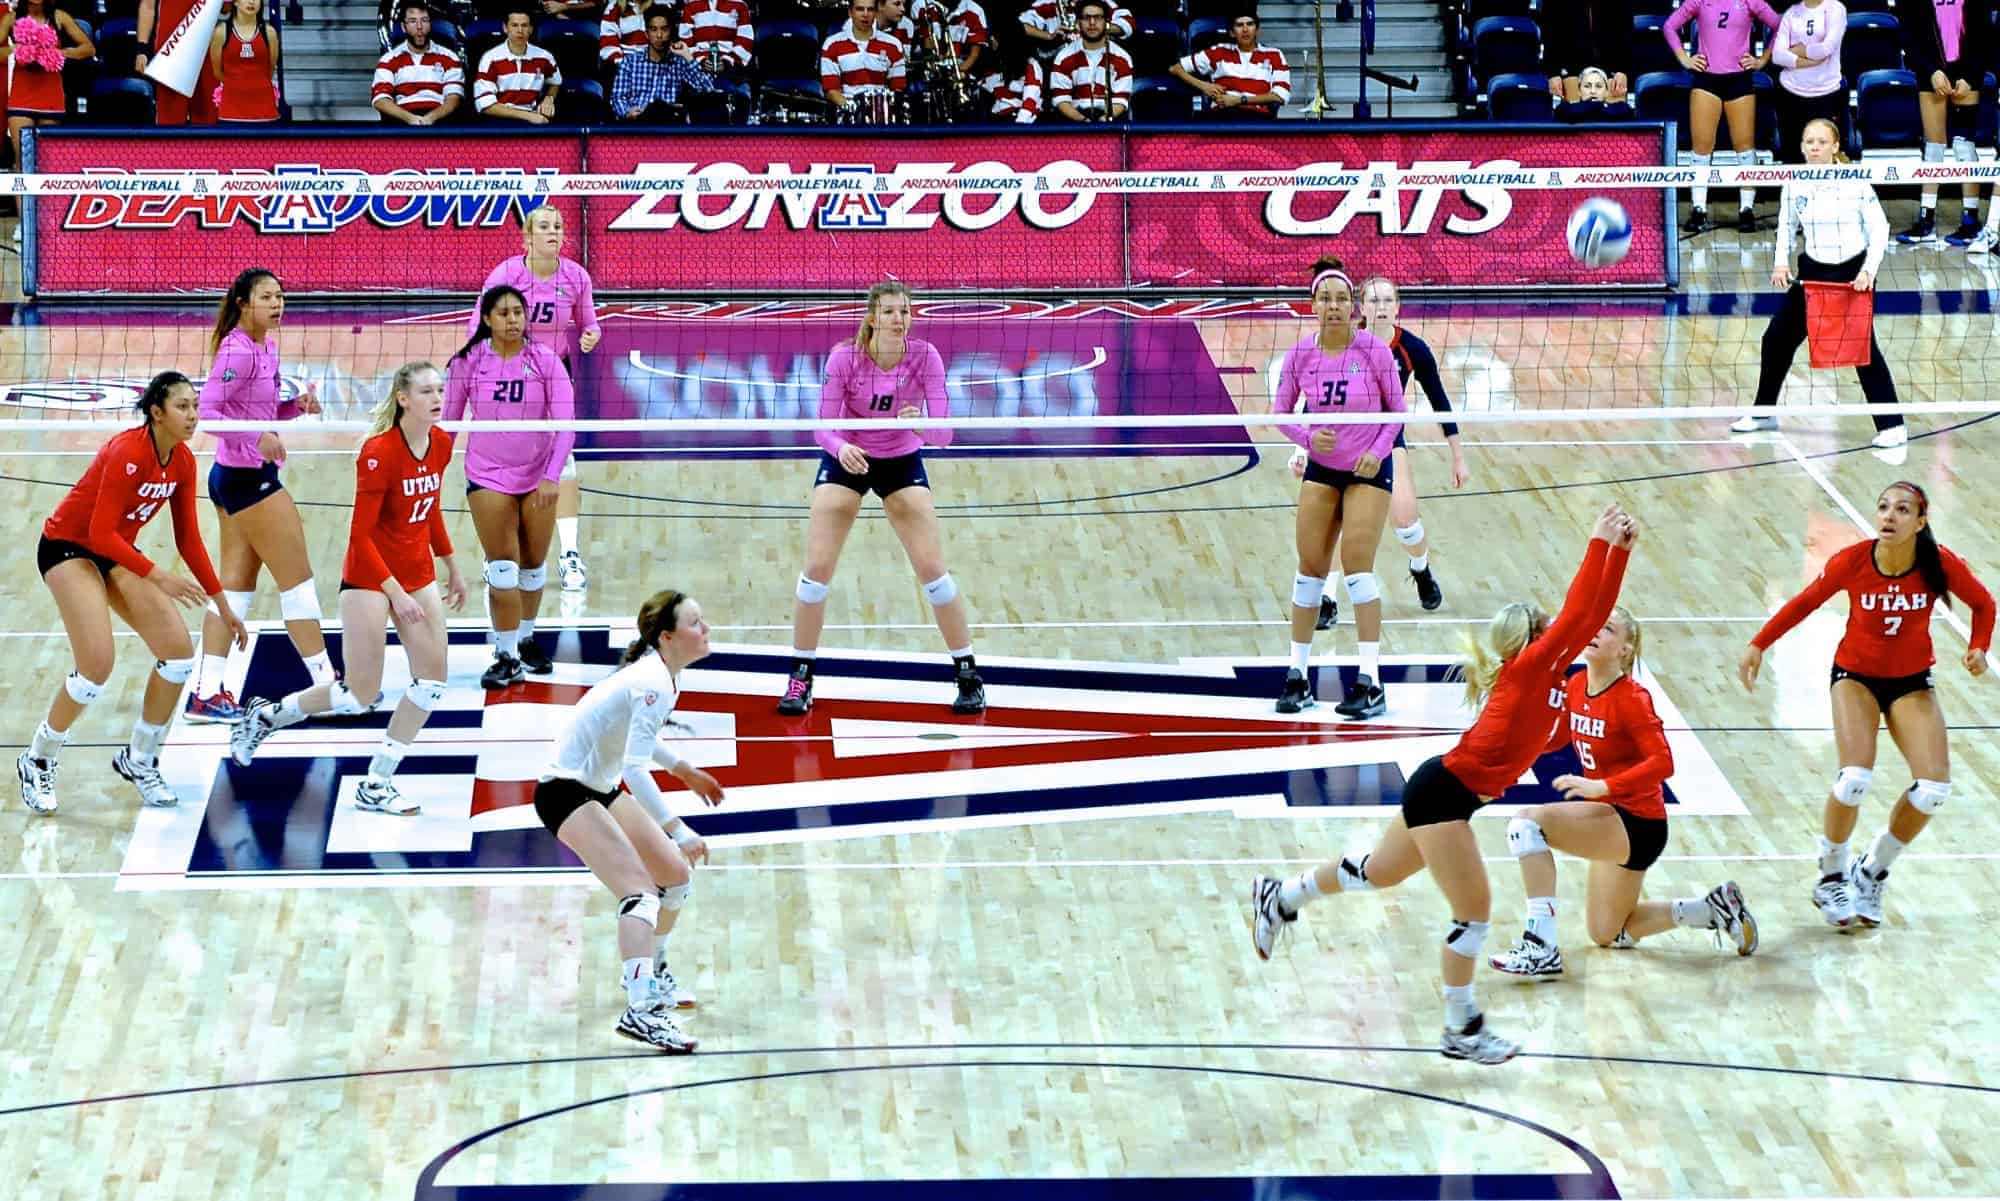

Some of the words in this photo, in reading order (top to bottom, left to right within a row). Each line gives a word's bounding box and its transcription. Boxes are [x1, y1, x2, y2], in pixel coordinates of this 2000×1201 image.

[1717, 12, 1729, 29] 2
[1806, 20, 1815, 36] 5
[40, 179, 181, 191] ARIZONAVOLLEYBALL
[220, 180, 344, 191] ARIZONAWILDCATS
[384, 180, 523, 191] ARIZONAVOLLEYBALL
[563, 179, 684, 190] ARIZONAWILDCATS
[724, 179, 862, 190] ARIZONAVOLLEYBALL
[902, 178, 1022, 189] ARIZONAWILDCATS
[1062, 176, 1199, 188] ARIZONAVOLLEYBALL
[1238, 175, 1359, 187] ARIZONAWILDCATS
[1398, 173, 1536, 185] ARIZONAVOLLEYBALL
[1575, 171, 1696, 183] ARIZONAWILDCATS
[1735, 167, 1872, 181] ARIZONAVOLLEYBALL
[64, 168, 268, 229] BEAR
[1265, 160, 1522, 236] CATS
[529, 302, 555, 323] 15
[493, 379, 524, 402] 20
[1319, 380, 1349, 406] 35
[869, 394, 893, 411] 18
[403, 472, 440, 497] UTAH
[408, 496, 434, 523] 17
[1861, 593, 1927, 611] UTAH
[1884, 616, 1903, 635] 7
[1575, 739, 1597, 770] 15
